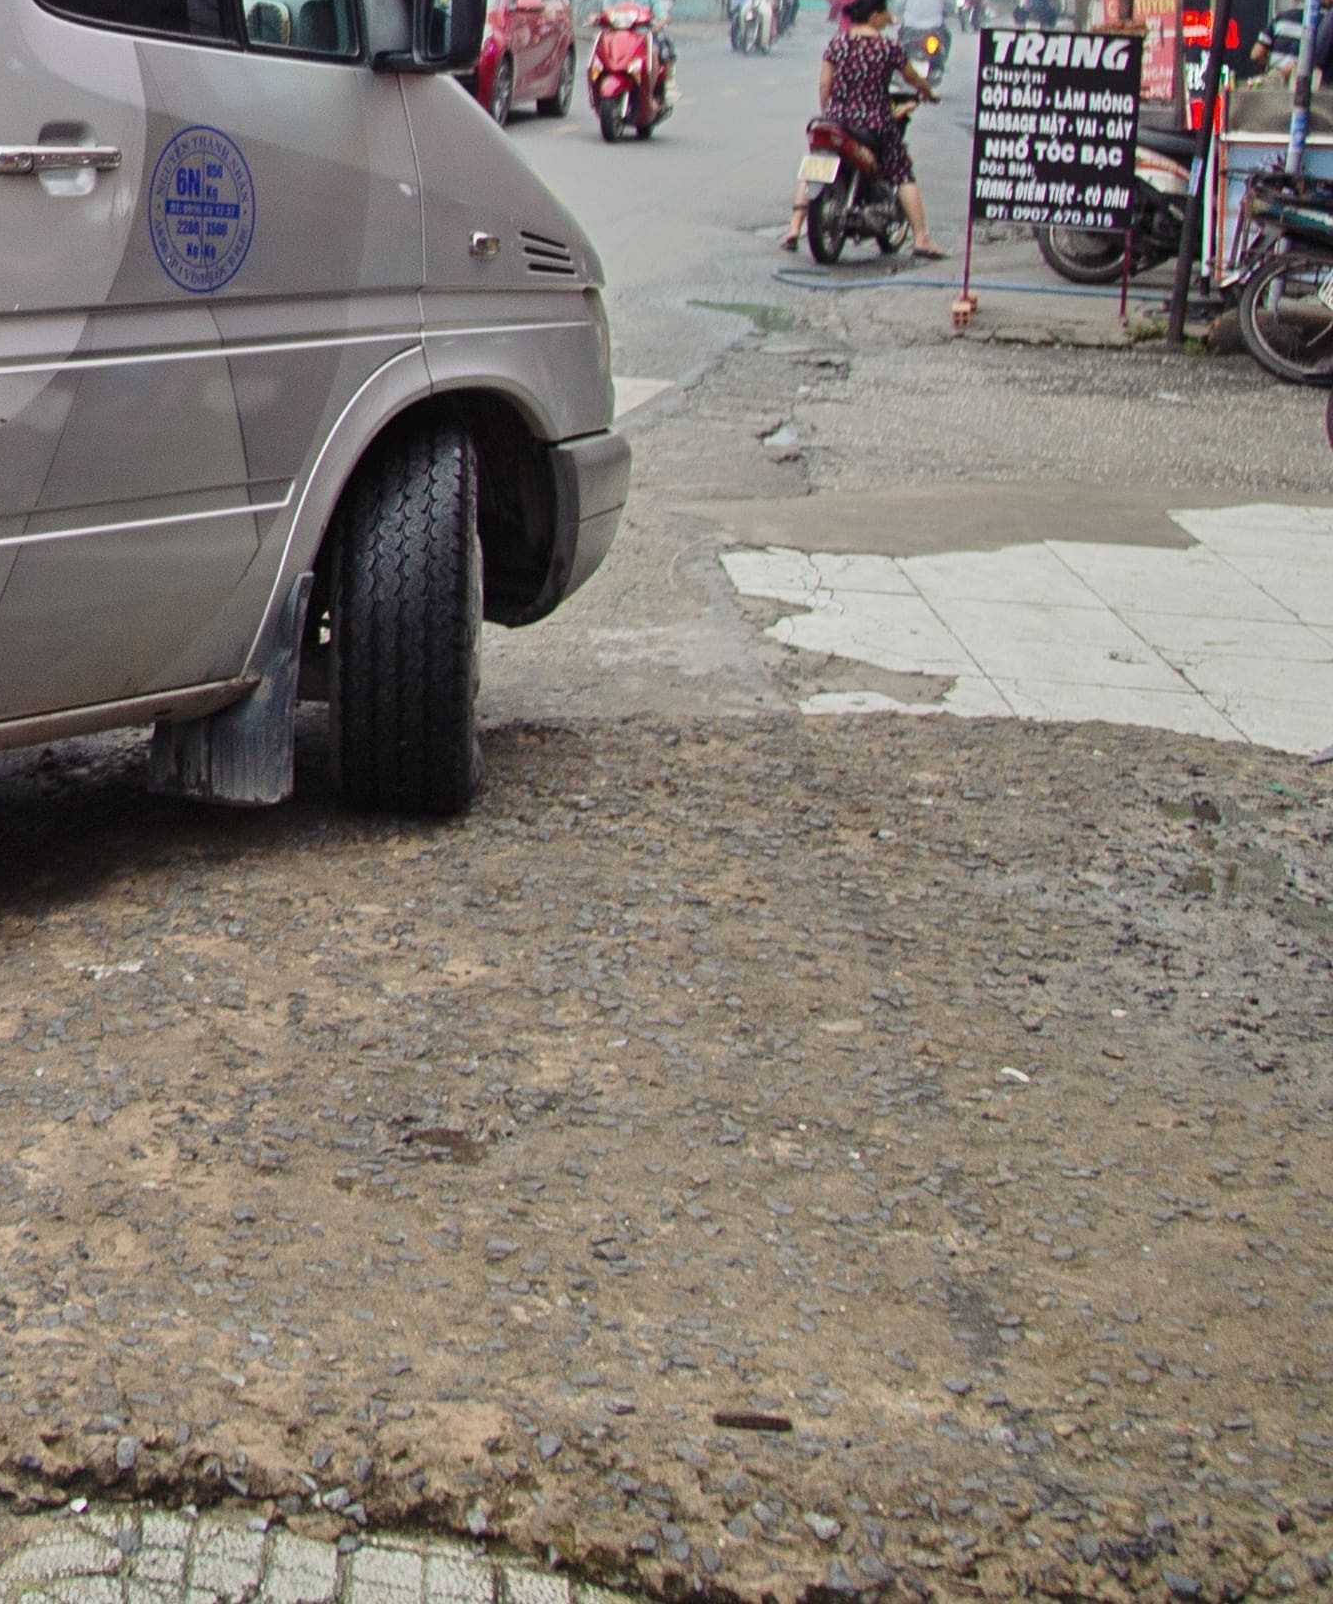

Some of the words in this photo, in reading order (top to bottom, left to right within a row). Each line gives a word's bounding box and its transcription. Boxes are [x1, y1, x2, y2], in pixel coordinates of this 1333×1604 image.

[992, 30, 1131, 70] TRANG
[981, 84, 1009, 110] GỘI
[1053, 86, 1086, 111] LÀM
[1089, 89, 1133, 114] MÓNG
[978, 111, 1037, 134] MASSAGE
[1076, 117, 1097, 138] VAI
[1034, 139, 1075, 163] TÓC
[1080, 145, 1123, 170] BẠC
[176, 167, 201, 197] 6N
[975, 176, 1013, 200] TRANG
